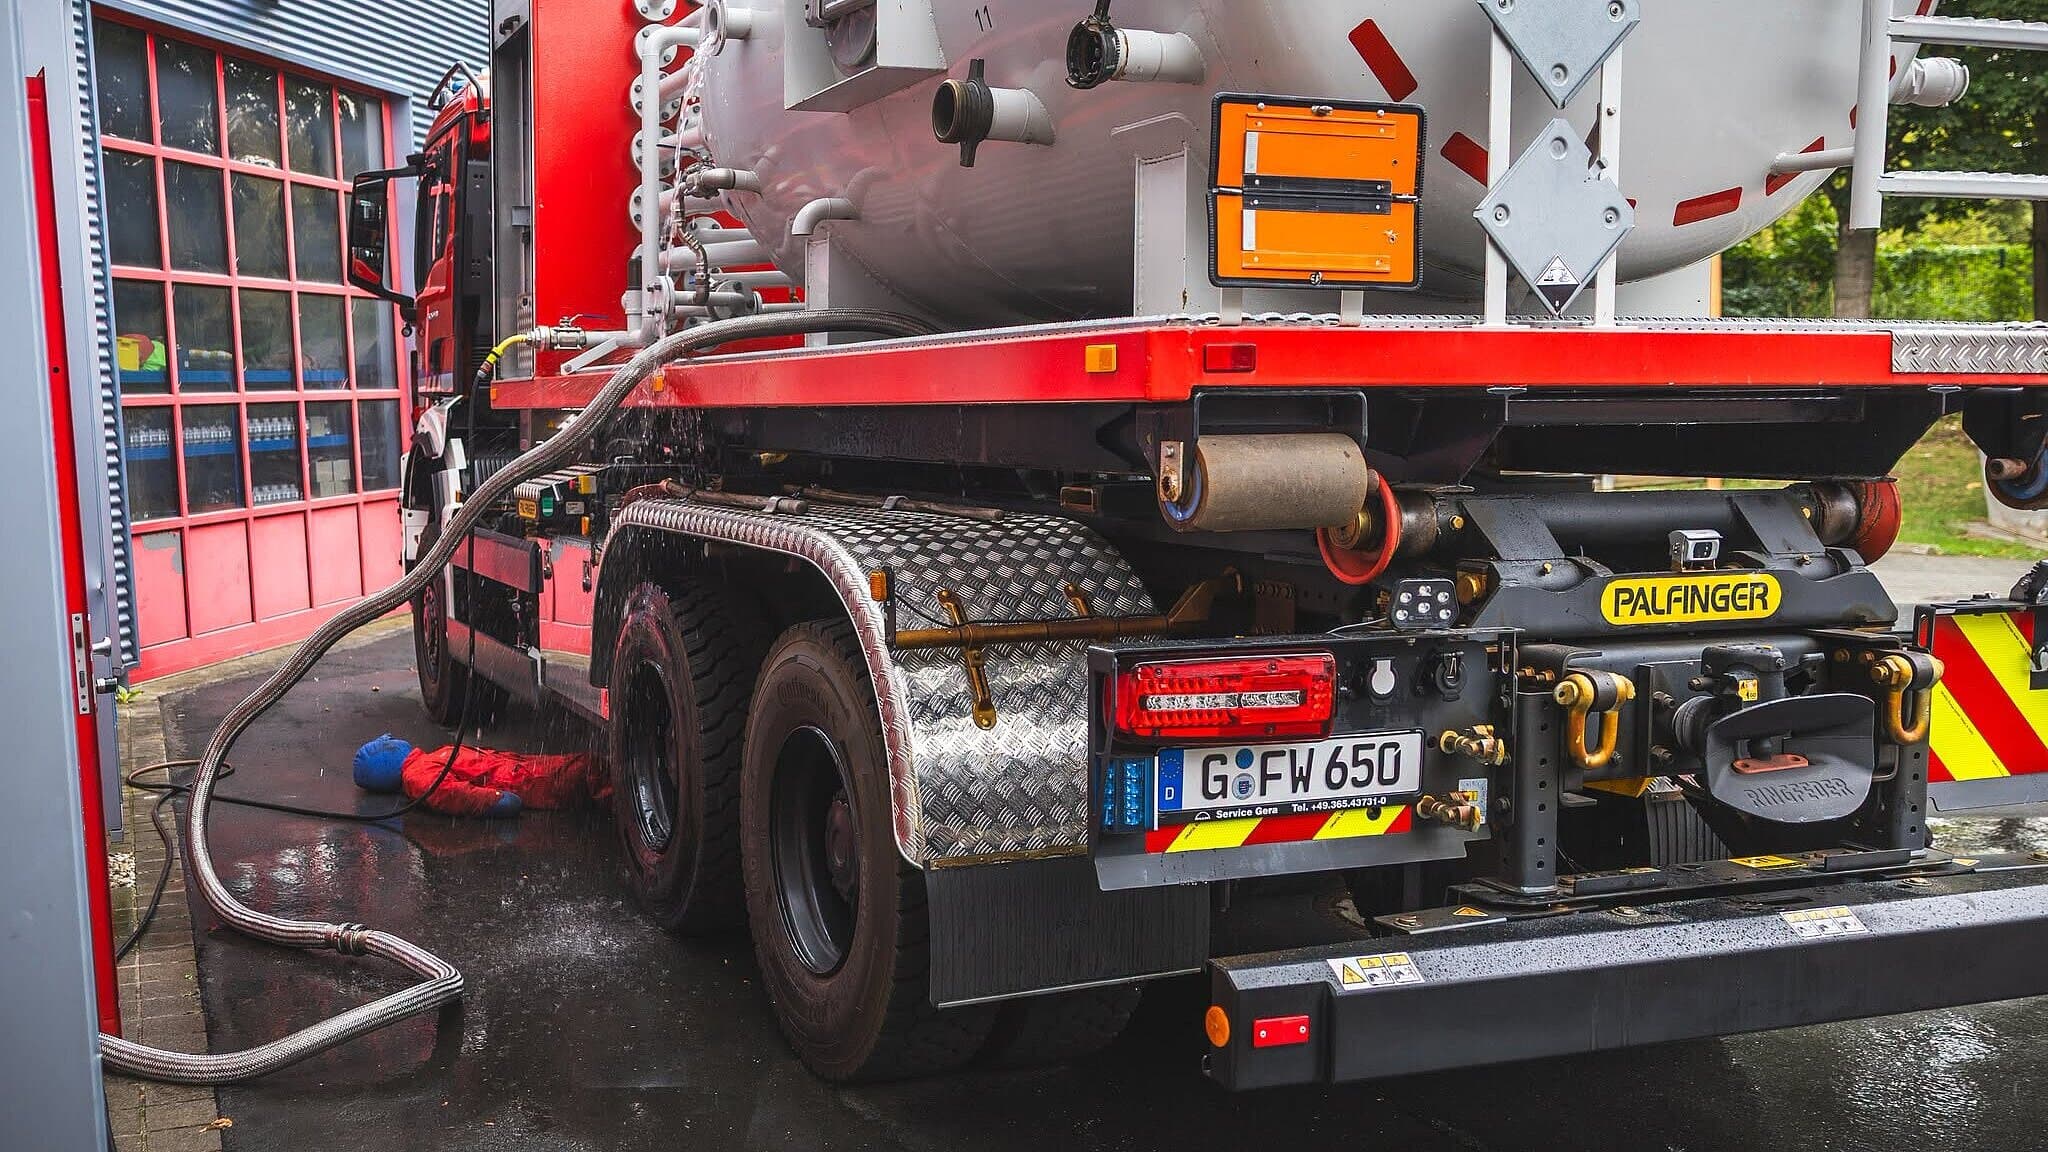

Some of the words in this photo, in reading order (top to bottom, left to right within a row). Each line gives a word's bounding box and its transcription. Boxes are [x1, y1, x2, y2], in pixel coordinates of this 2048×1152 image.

[974, 5, 992, 32] 11
[1613, 581, 1769, 618] PALFINGER
[1202, 753, 1228, 801] G
[1260, 747, 1315, 797] FW
[1325, 741, 1401, 791] 650
[1165, 786, 1175, 801] D
[1743, 778, 1856, 808] RINGFEDER
[1215, 808, 1253, 819] Service
[1255, 806, 1278, 816] Gera
[1291, 803, 1309, 813] Tel.
[1311, 797, 1387, 812] +49.365.43731-0
